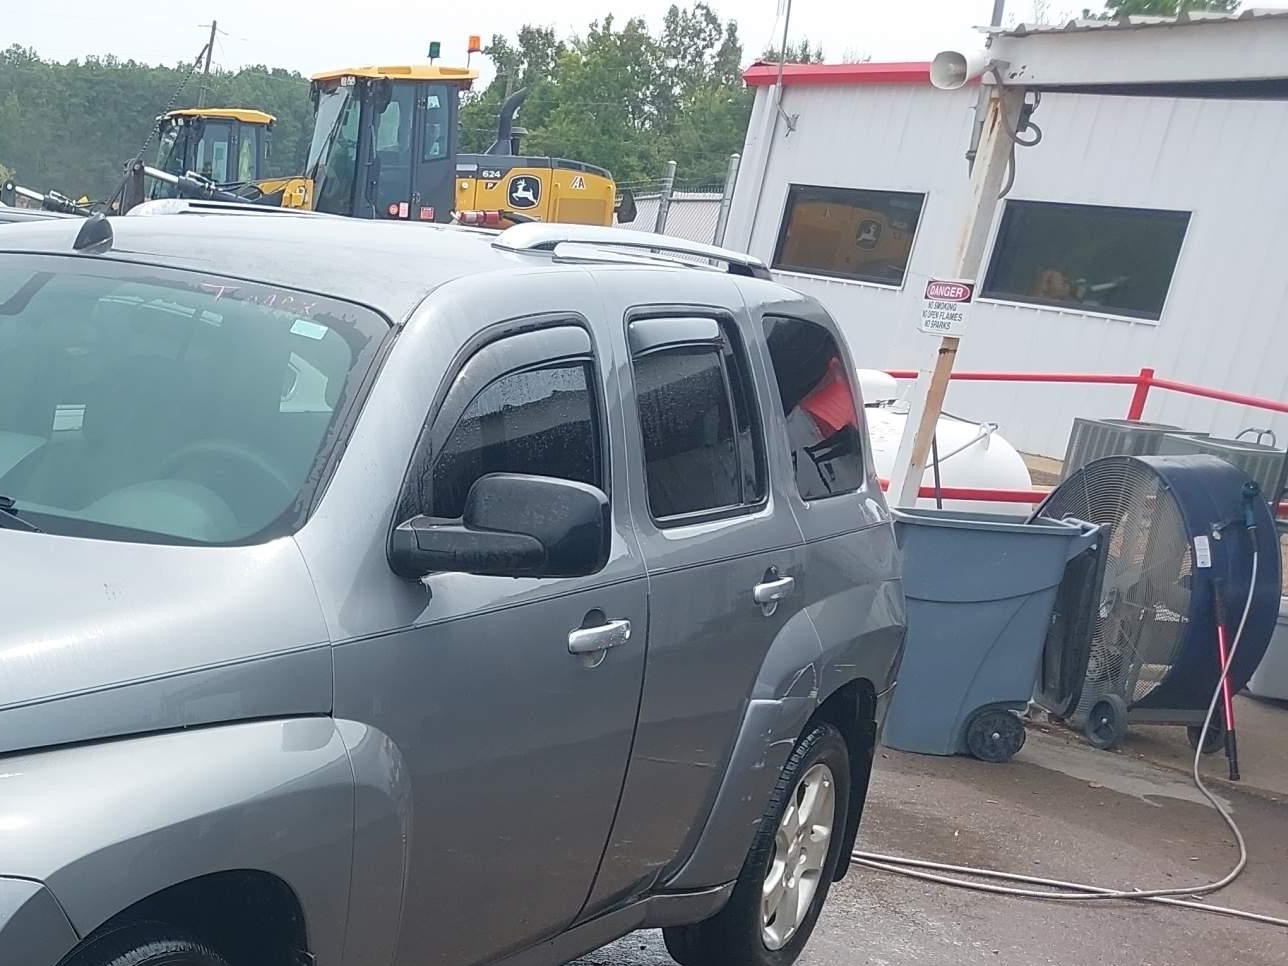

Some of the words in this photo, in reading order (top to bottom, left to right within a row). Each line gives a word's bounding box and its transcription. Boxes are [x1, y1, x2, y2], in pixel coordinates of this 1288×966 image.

[482, 170, 501, 178] 624
[487, 181, 494, 189] P
[929, 285, 964, 298] DANGER
[934, 302, 957, 311] SMOKING
[939, 311, 963, 322] FLAMES
[931, 320, 951, 330] SPARKS
